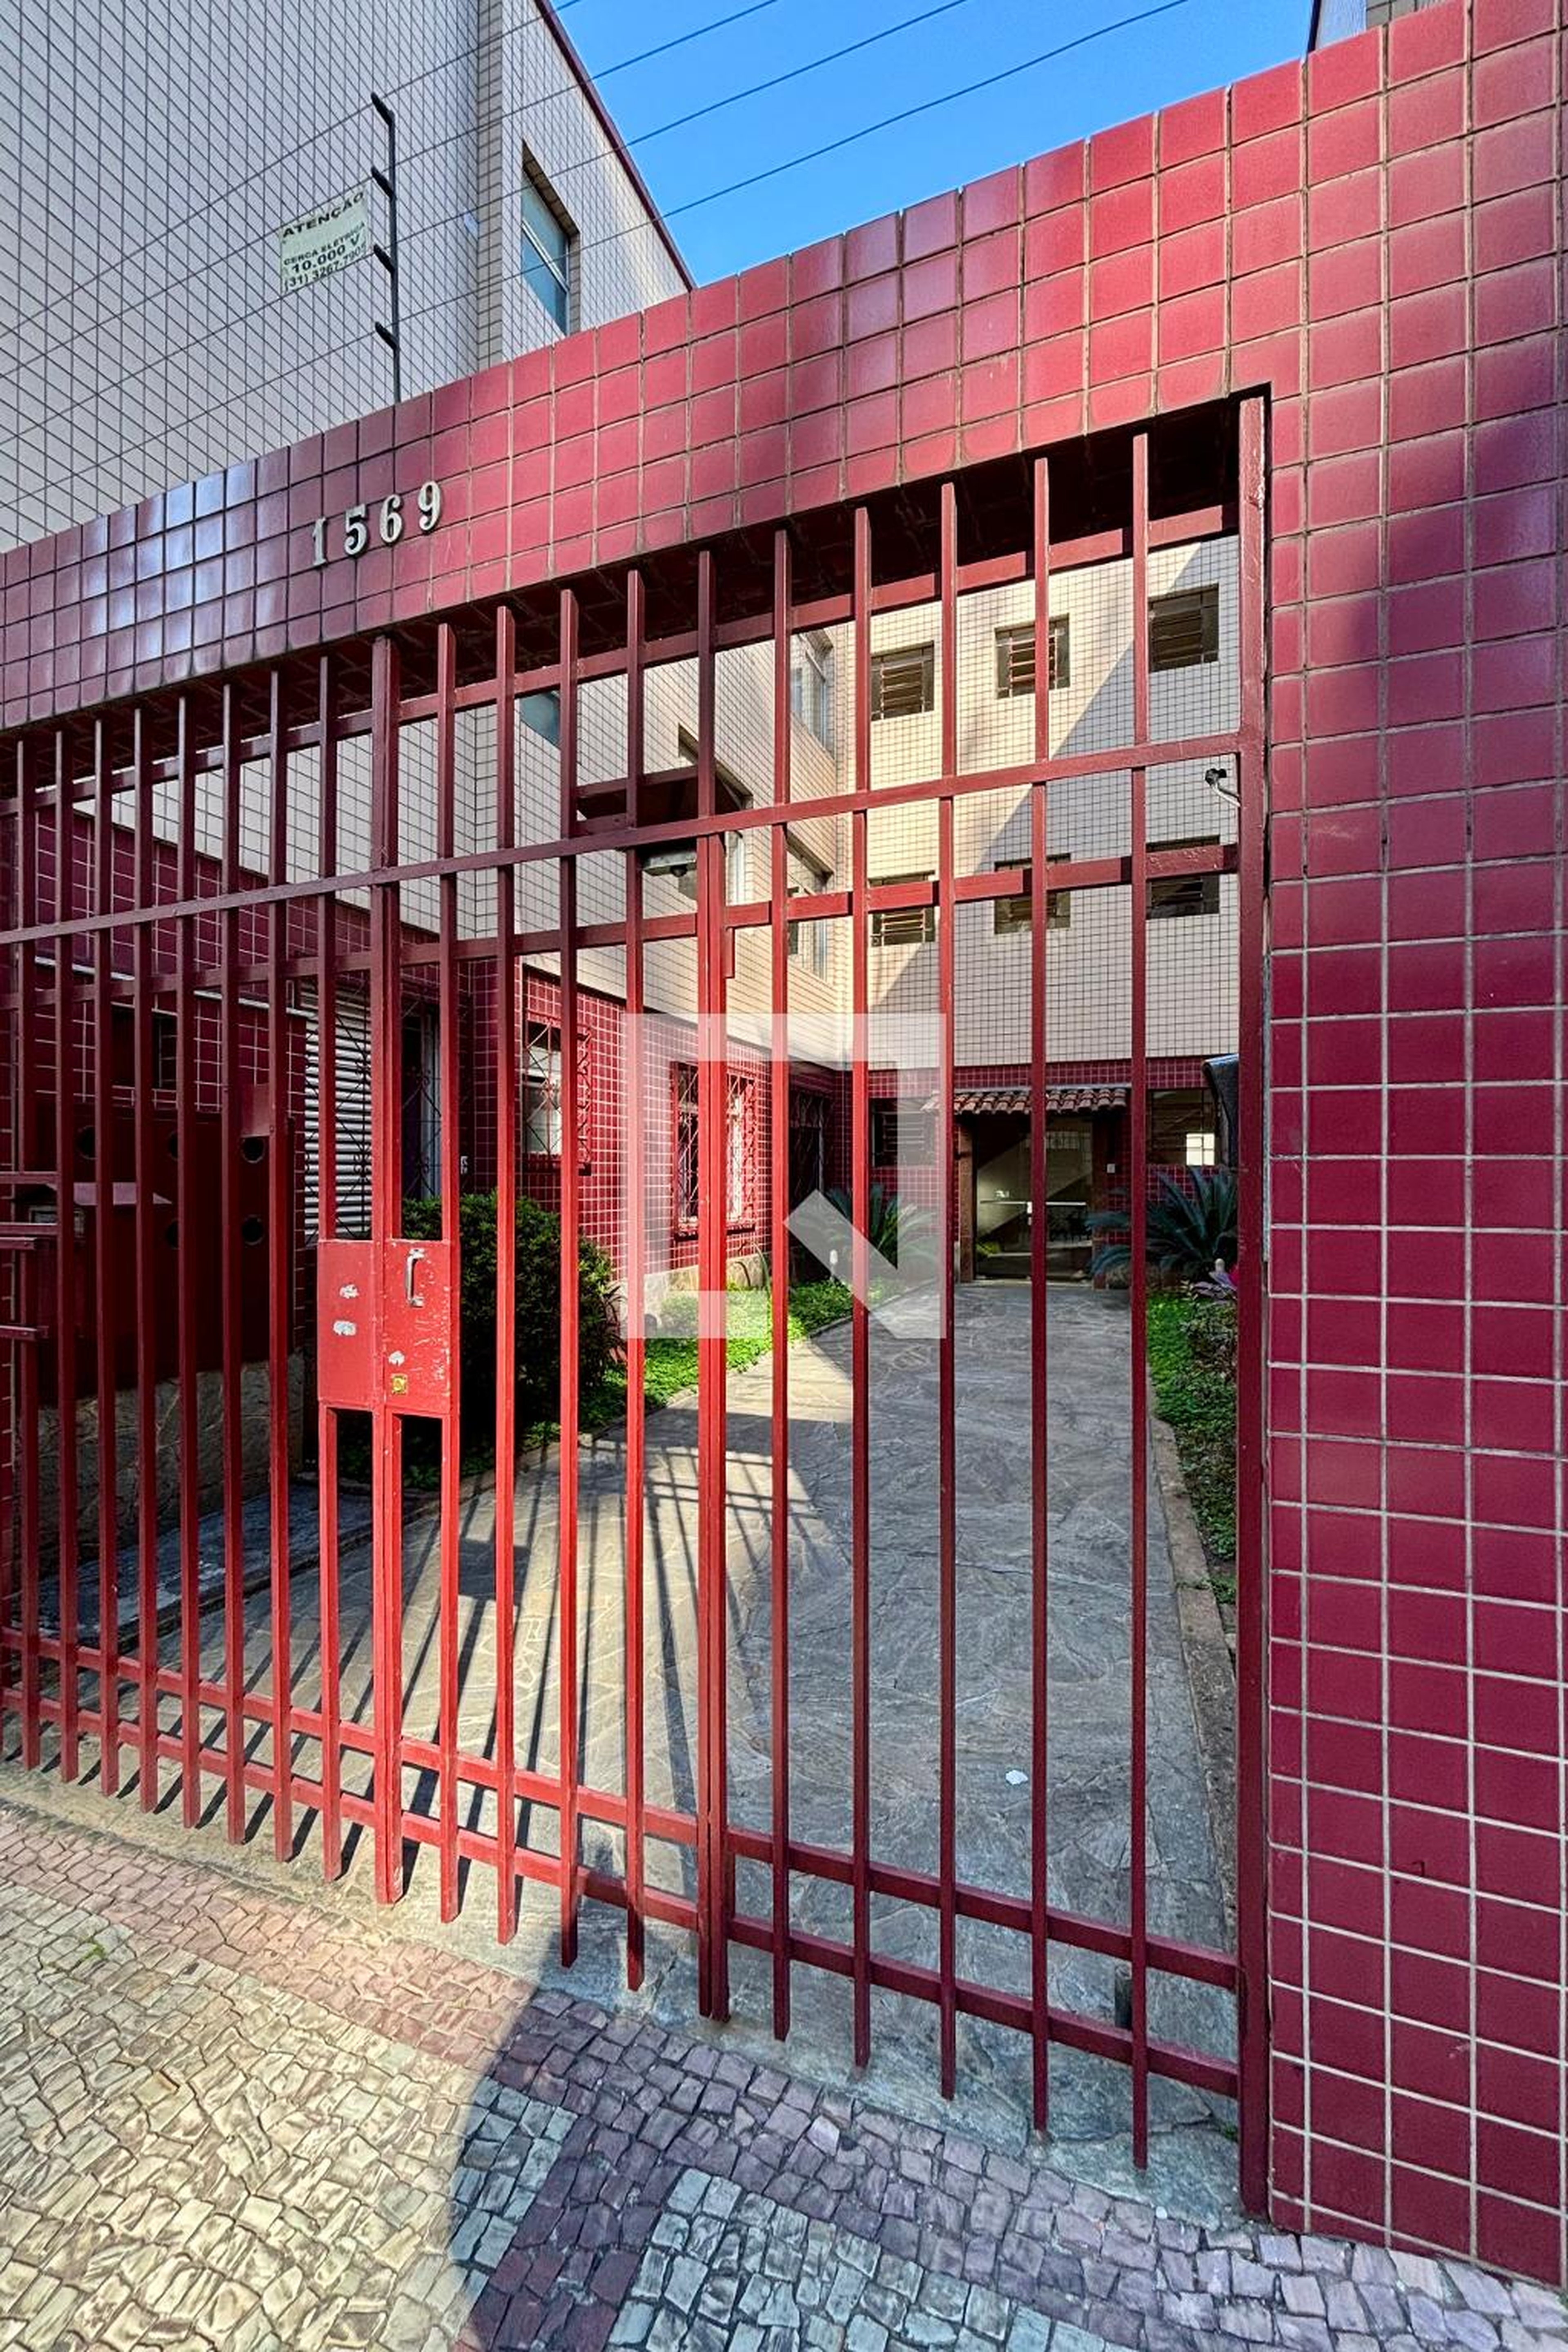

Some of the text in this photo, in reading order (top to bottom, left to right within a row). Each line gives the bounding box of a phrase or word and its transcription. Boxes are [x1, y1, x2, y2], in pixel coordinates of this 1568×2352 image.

[284, 249, 318, 265] CERCA
[292, 233, 359, 273] 10.000 V
[285, 273, 309, 291] (31)
[312, 481, 441, 566] 1569
